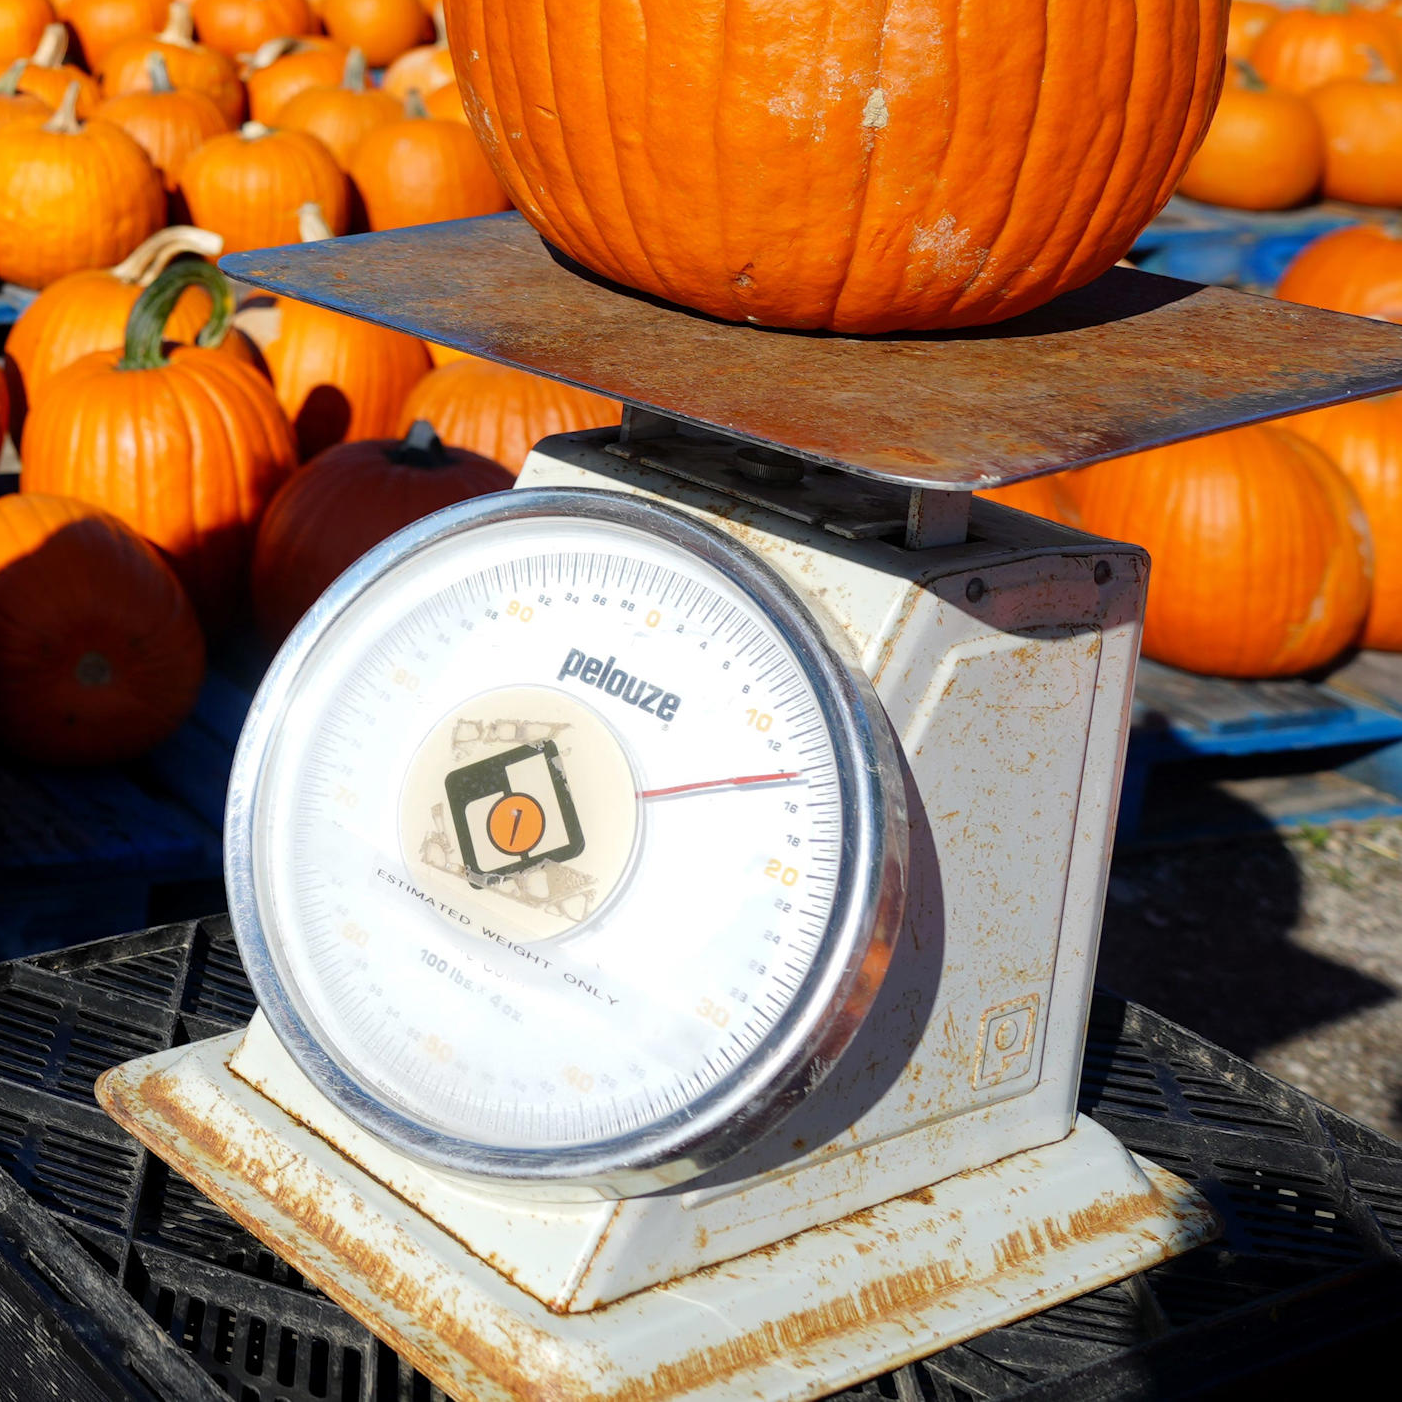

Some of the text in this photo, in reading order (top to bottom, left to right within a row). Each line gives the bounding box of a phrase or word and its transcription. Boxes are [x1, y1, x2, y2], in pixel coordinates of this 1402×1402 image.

[538, 594, 553, 606] 92
[565, 593, 580, 604] 94
[591, 594, 607, 606] 96
[620, 599, 635, 612] 98
[506, 600, 534, 622] 90
[645, 610, 661, 628] 0
[676, 624, 685, 634] 2
[699, 641, 708, 650] 4
[722, 660, 731, 670] 6
[395, 669, 420, 692] 80
[556, 648, 682, 722] pelouze
[742, 684, 751, 694] 8
[745, 708, 773, 732] 10
[767, 739, 782, 751] 12
[334, 785, 359, 809] 70
[783, 802, 799, 814] 16
[785, 834, 800, 847] 18
[764, 858, 799, 887] 20
[773, 898, 793, 913] 22
[376, 868, 472, 926] ESTIMATED
[482, 926, 554, 970] WEIGHT
[563, 973, 620, 1007] ONLY
[764, 930, 781, 945] 24
[420, 949, 448, 973] 100
[449, 967, 474, 992] lbs.
[489, 994, 502, 1008] 4
[695, 996, 730, 1029] 30
[425, 1035, 453, 1062] 50
[563, 1065, 594, 1093] 40
